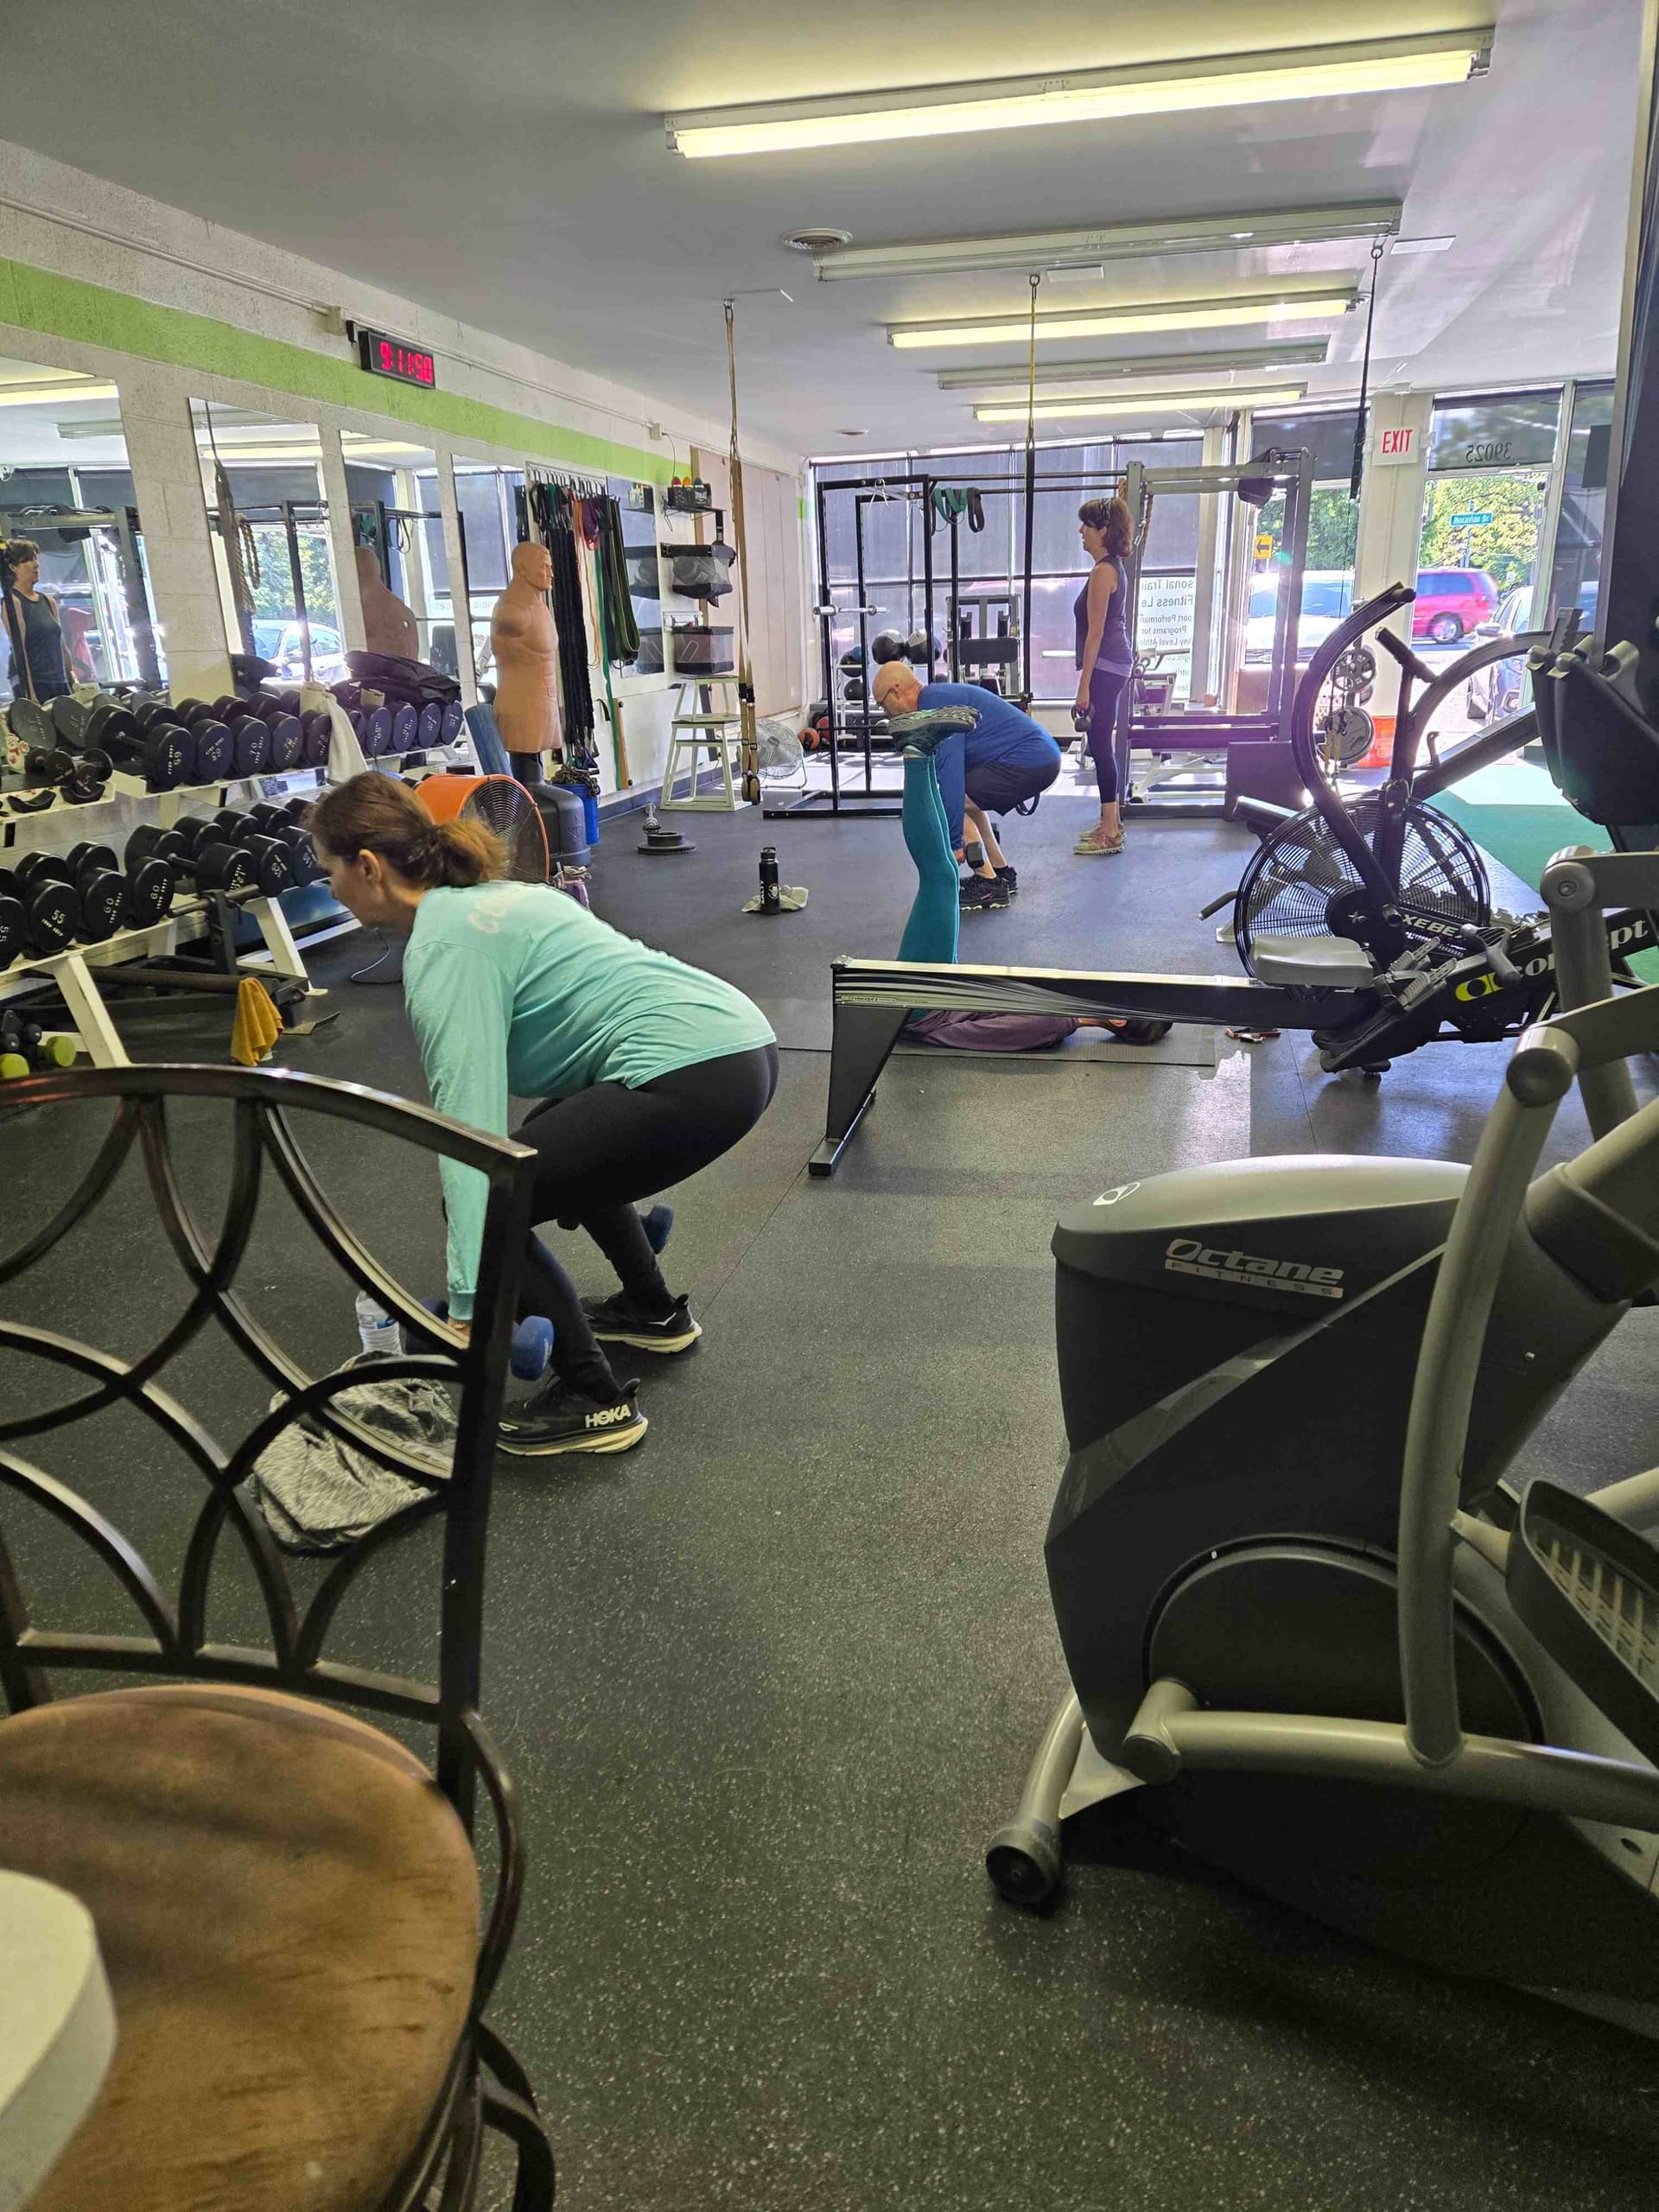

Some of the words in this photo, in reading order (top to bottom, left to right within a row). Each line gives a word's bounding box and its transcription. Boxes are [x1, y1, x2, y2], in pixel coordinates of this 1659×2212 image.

[1382, 429, 1413, 454] EXIT
[51, 909, 66, 925] 55
[1402, 913, 1463, 938] XEBE
[1166, 1238, 1344, 1285] Octane
[1170, 1262, 1333, 1296] FITNESS
[584, 1403, 632, 1428] HOKA
